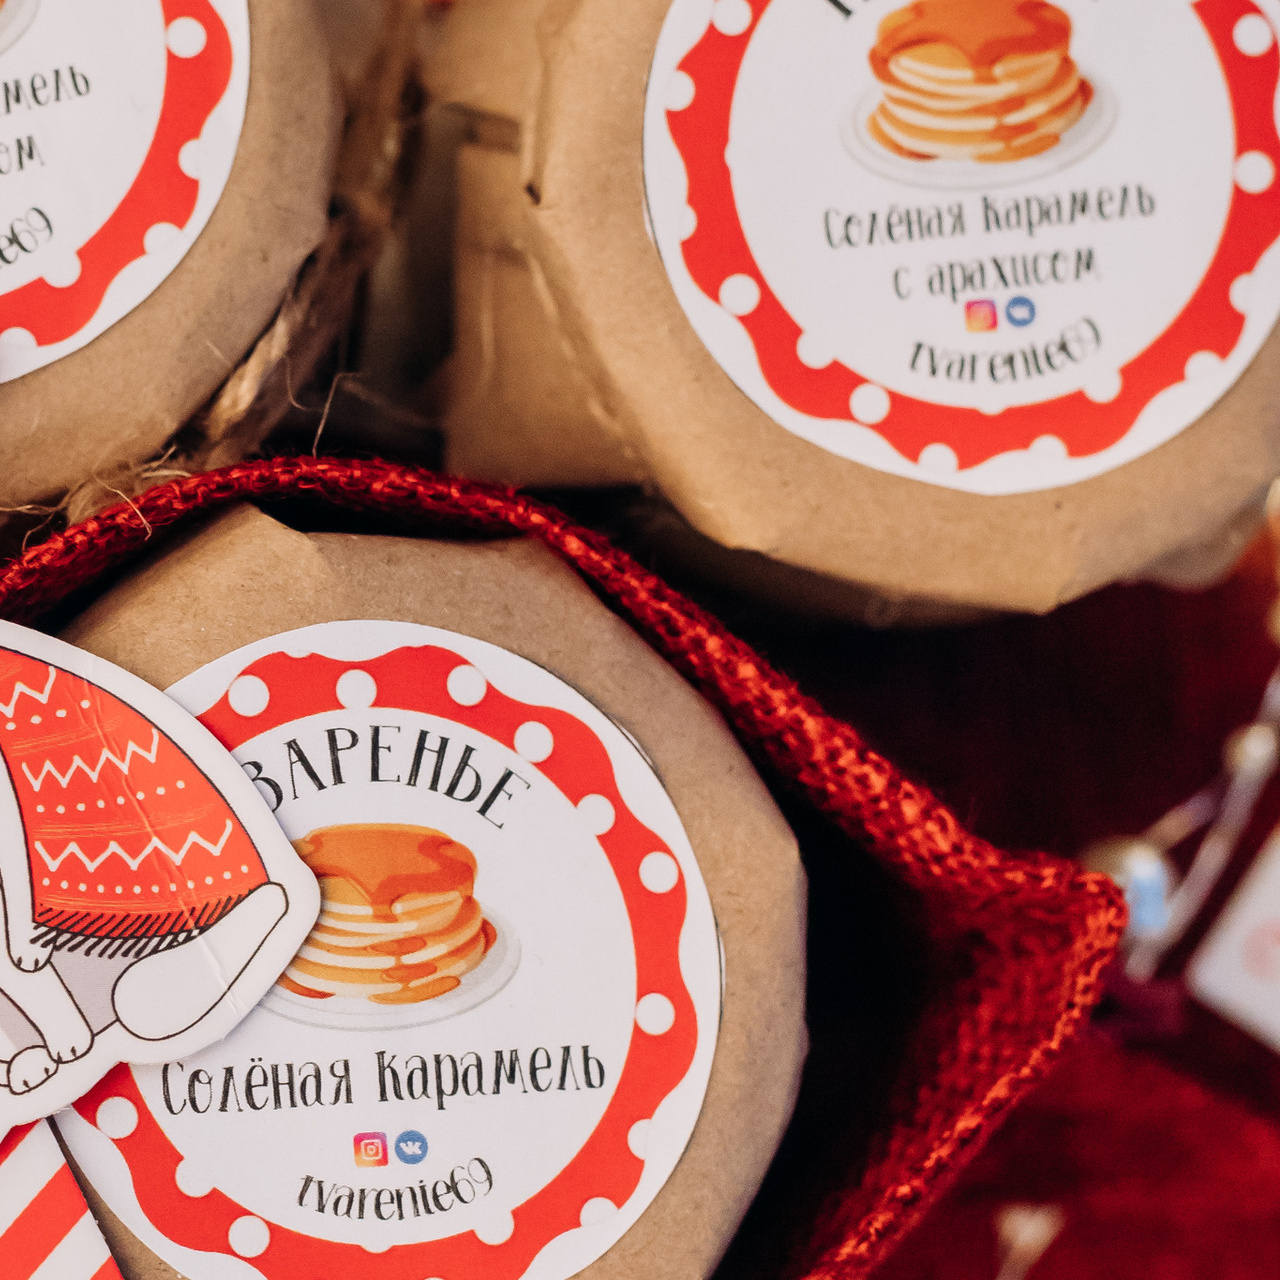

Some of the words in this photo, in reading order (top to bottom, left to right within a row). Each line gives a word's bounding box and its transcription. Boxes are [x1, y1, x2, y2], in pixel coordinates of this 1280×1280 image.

[928, 247, 1103, 302] арахисом
[240, 724, 531, 829] ВАРЕНЬЕ
[161, 1056, 354, 1116] Солёная
[297, 1157, 493, 1221] tvarenie69
